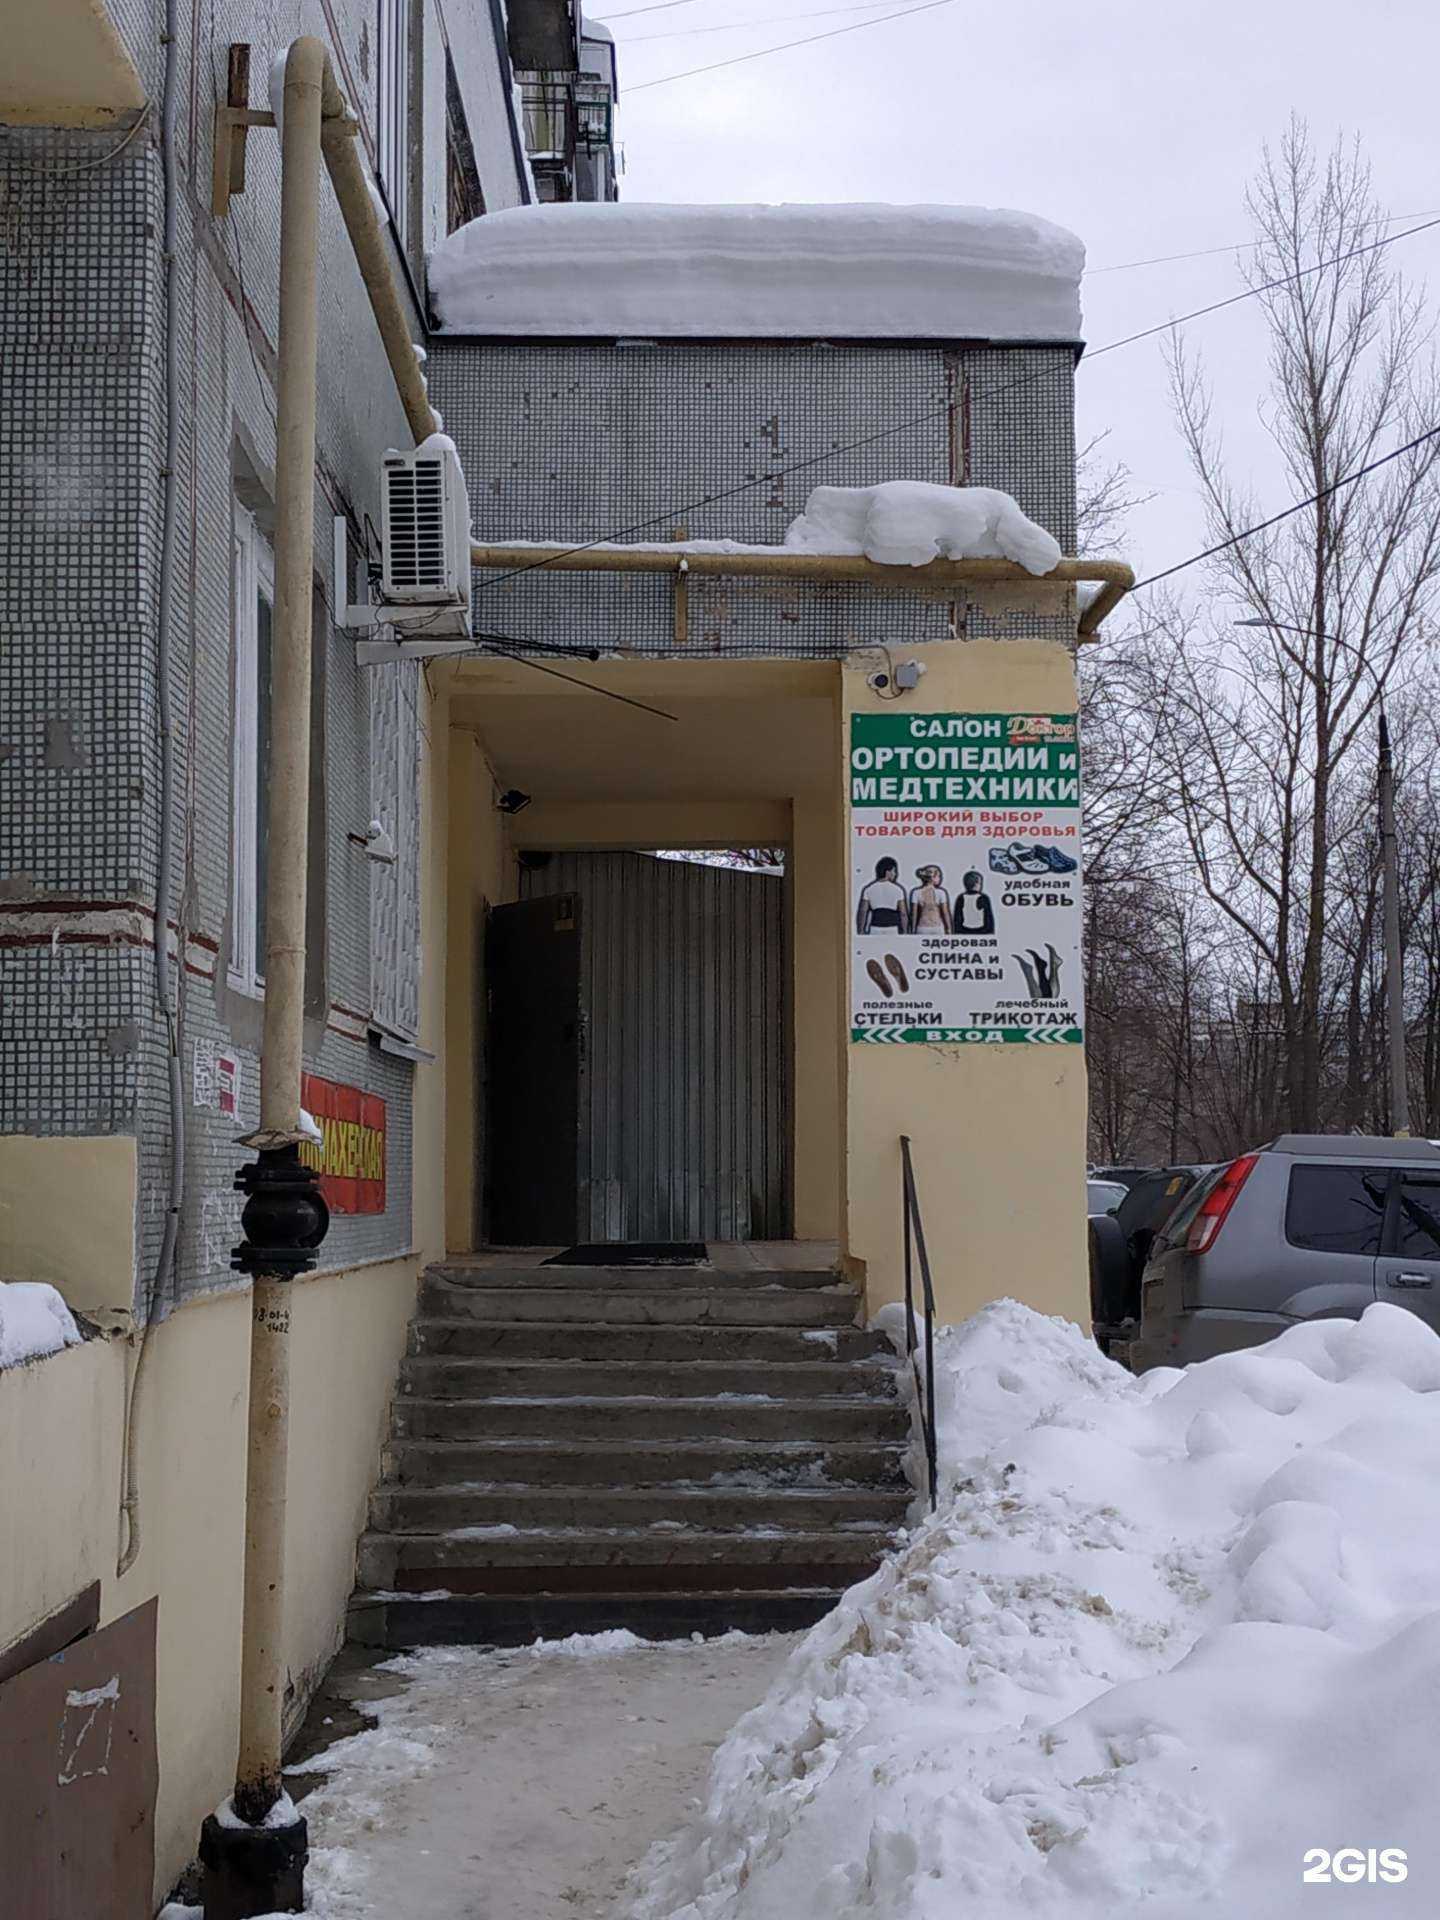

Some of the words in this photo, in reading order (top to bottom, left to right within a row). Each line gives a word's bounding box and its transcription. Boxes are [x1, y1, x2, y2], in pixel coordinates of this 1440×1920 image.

[910, 719, 1001, 738] САЛОН
[851, 747, 1049, 772] ОРТОПЕДИИ
[1059, 753, 1077, 771] и
[851, 777, 1079, 803] МЕДТЕХНИКИ
[883, 810, 974, 823] ШИРОКИЙ
[980, 811, 1044, 823] ВЫБОР
[855, 826, 937, 837] ТОВАРОВ
[941, 826, 976, 838] ДЛЯ
[982, 825, 1076, 838] ЗДОРОВЬЯ
[1004, 878, 1070, 892] удобная
[1001, 893, 1074, 907] ОБУВЬ
[921, 938, 998, 950] здоровая
[918, 952, 983, 965] СПИНА
[988, 954, 1000, 965] и
[914, 967, 1004, 981] СУСТАВЫ
[863, 1000, 933, 1010] полезные
[995, 998, 1069, 1009] лечебный
[854, 1012, 943, 1025] СТЕЛЬКИ
[970, 1011, 1078, 1025] ТРИКОТАЖ
[926, 1030, 1004, 1043] ВХОД
